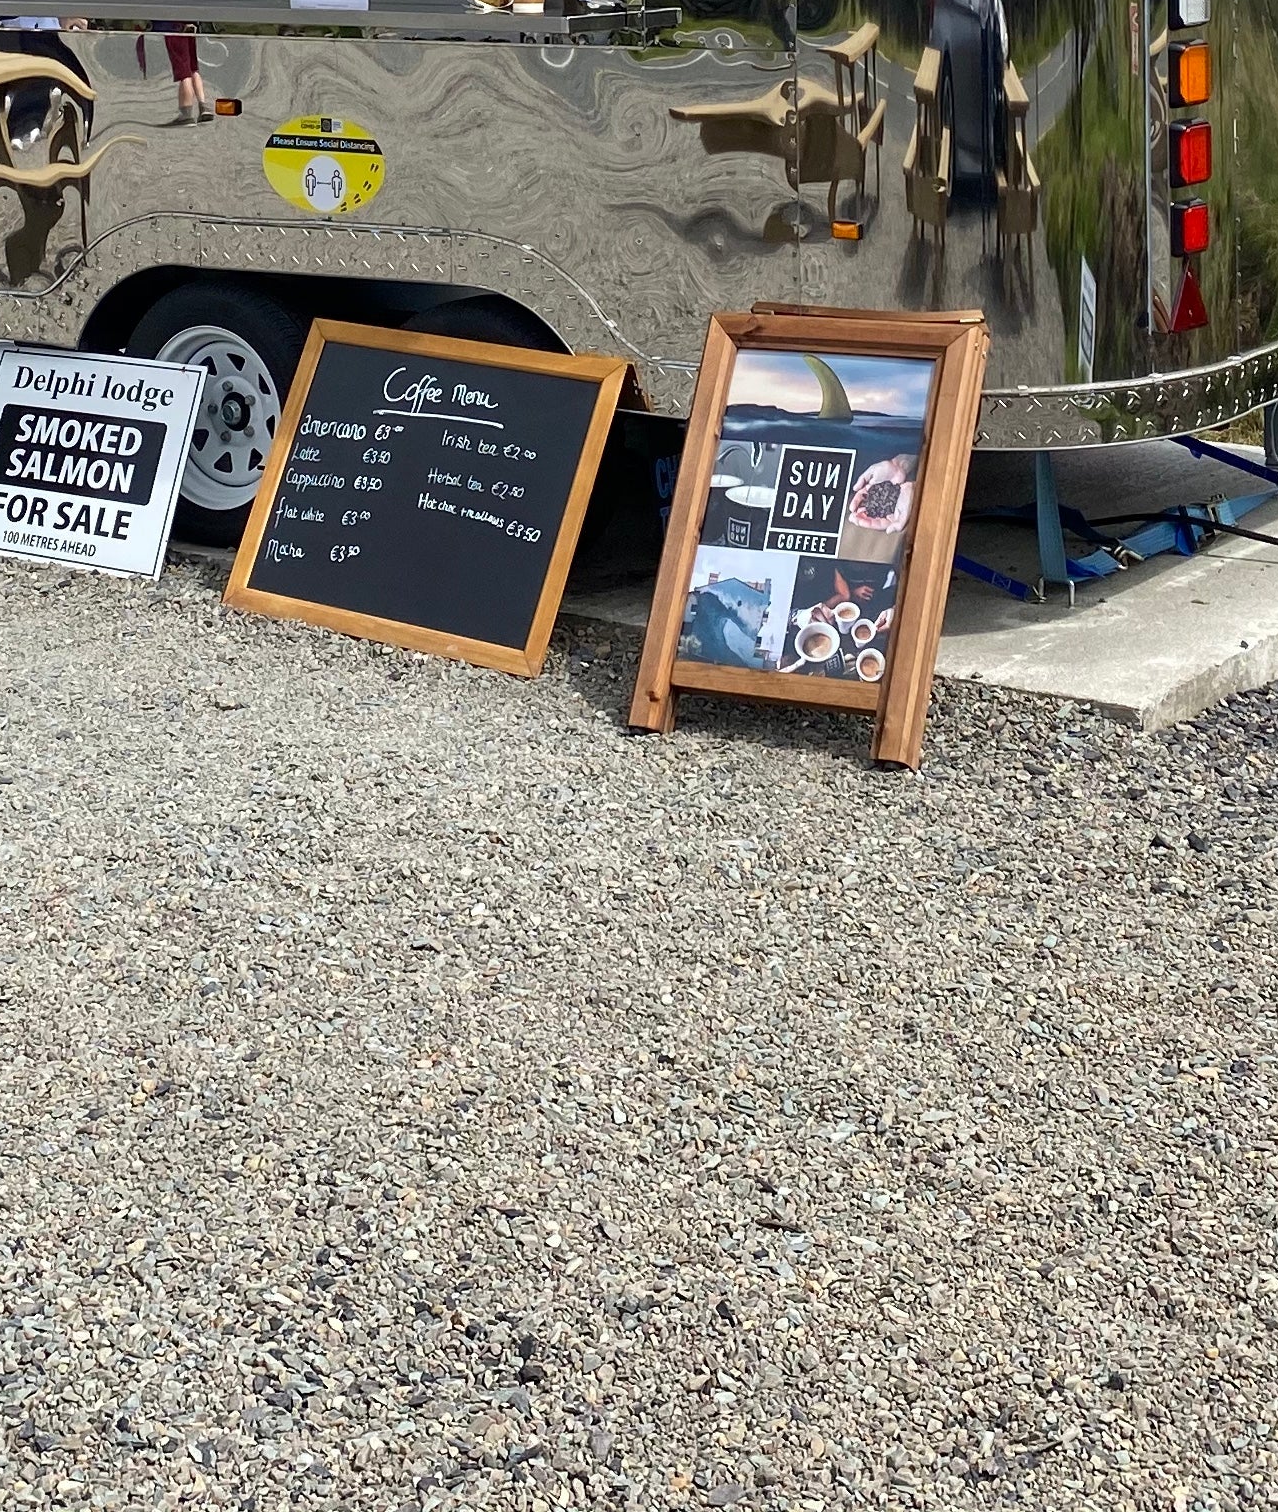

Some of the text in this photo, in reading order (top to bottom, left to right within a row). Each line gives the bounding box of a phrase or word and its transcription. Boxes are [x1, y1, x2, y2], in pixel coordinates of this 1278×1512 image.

[273, 136, 375, 152] Please Ensure Social Distancing
[13, 365, 174, 412] Delphi lodge
[383, 366, 442, 414] Coffee
[15, 413, 143, 457] SMOKED
[441, 429, 472, 451] Irish
[477, 439, 499, 457] tea
[291, 442, 322, 462] Latte
[5, 448, 135, 494] SALMON
[285, 467, 345, 492] Cappuccino
[427, 467, 462, 487] Herbal
[467, 474, 485, 492] tea
[789, 460, 841, 489] SUN
[417, 492, 437, 510] Hot
[783, 491, 835, 521] DAY
[53, 501, 132, 541] SALE
[2, 530, 97, 557] 100 METRES AHEAD
[265, 539, 306, 563] Mocha
[777, 533, 827, 553] COFFEE
